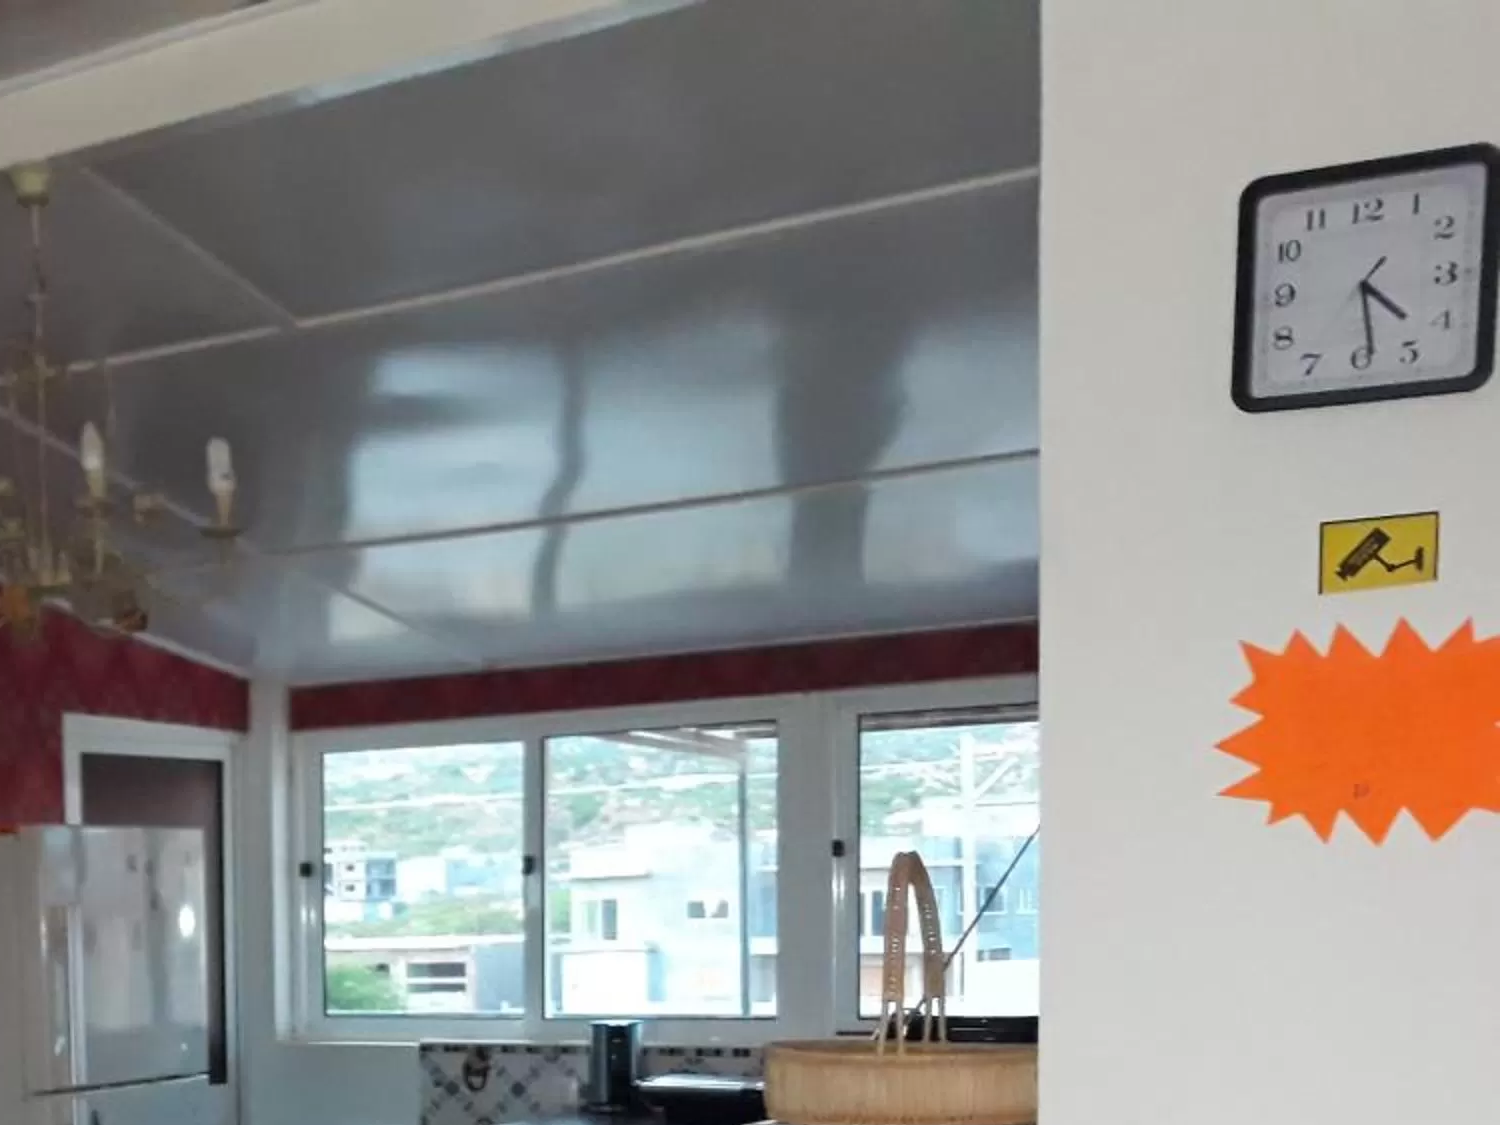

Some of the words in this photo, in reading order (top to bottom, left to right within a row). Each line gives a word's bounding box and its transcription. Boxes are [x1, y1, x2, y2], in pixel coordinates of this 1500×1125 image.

[1351, 199, 1385, 225] 12
[1410, 193, 1421, 215] 1
[1306, 208, 1327, 231] 11
[1433, 215, 1456, 240] 2
[1277, 239, 1301, 262] 10
[1433, 261, 1458, 286] 3
[1274, 283, 1296, 308] 9
[1430, 308, 1451, 330] 4
[1272, 325, 1294, 351] 8
[1300, 353, 1322, 376] 7
[1350, 346, 1373, 370] 6
[1399, 340, 1420, 365] 5
